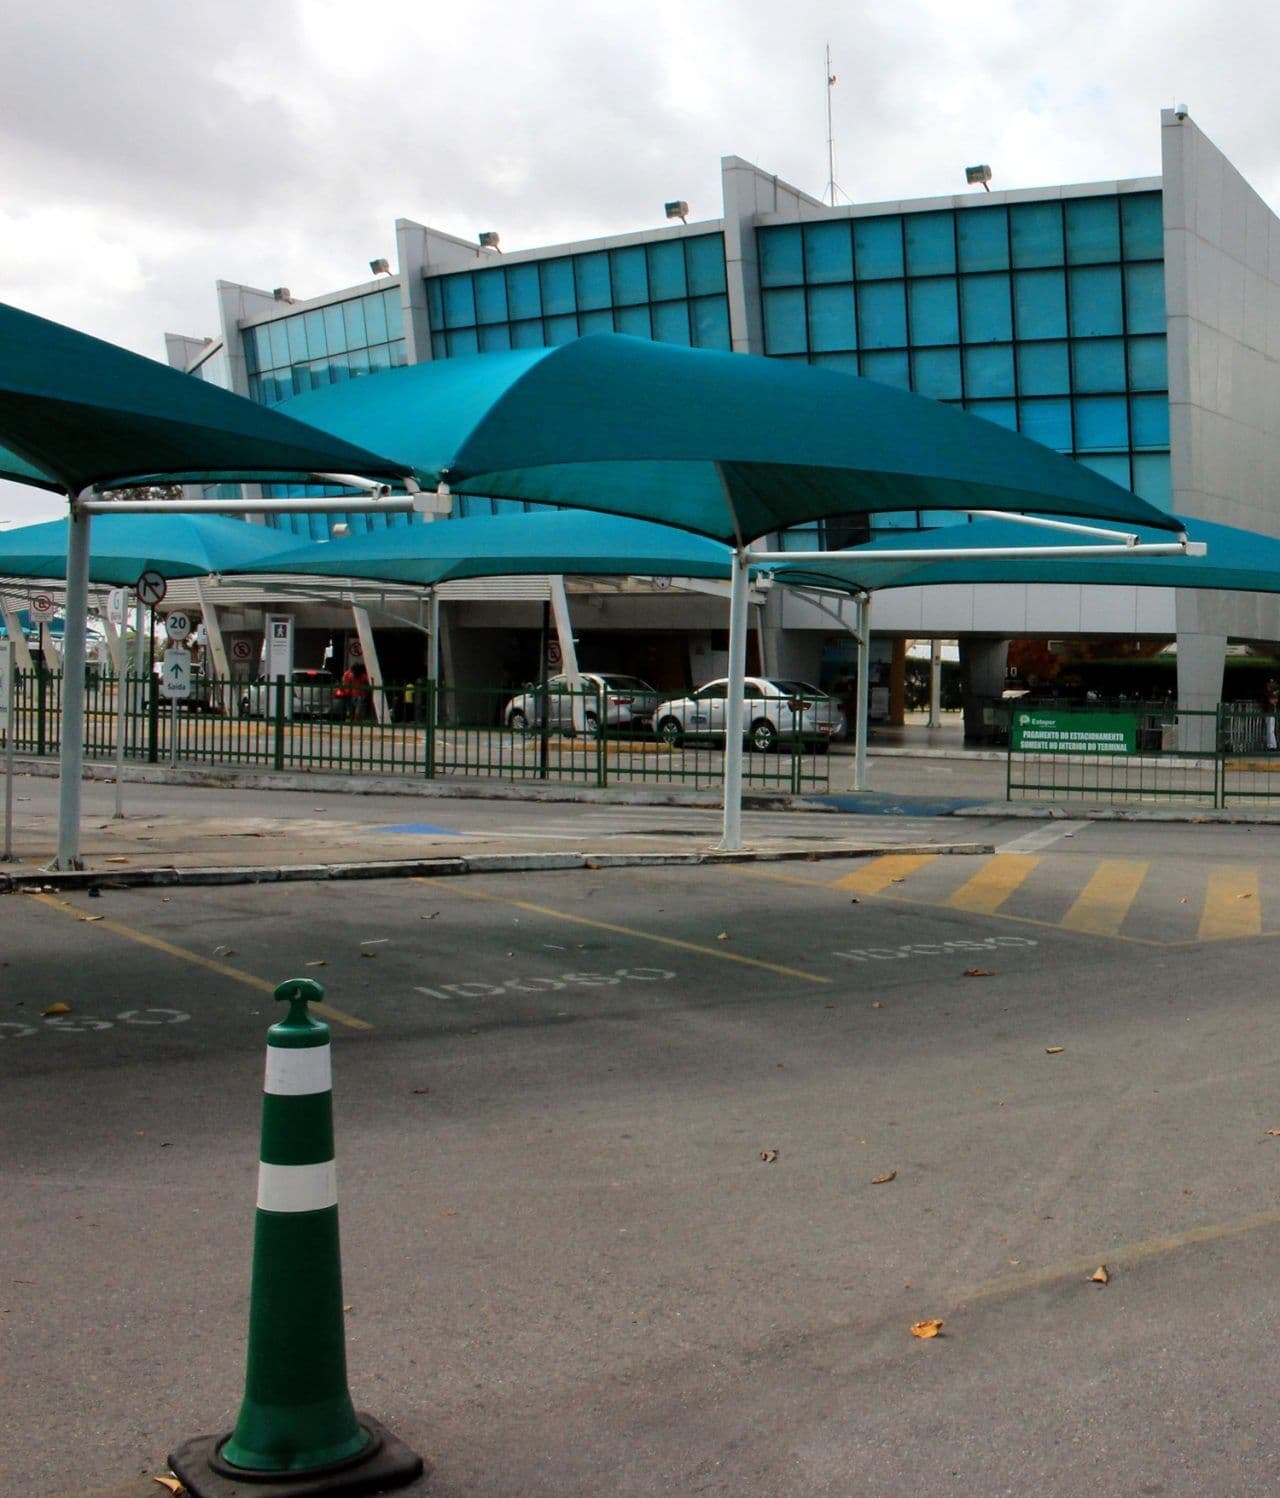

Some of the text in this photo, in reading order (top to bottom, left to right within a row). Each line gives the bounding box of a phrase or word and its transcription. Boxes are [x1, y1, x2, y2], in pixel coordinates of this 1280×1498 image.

[170, 616, 186, 629] 20
[1023, 730, 1124, 741] PAGAMENTO DO ESTACIONAMENTO
[1020, 740, 1048, 750] SOMENTE
[1058, 742, 1087, 751] INTERIOR
[1097, 743, 1128, 752] TERMINAL
[832, 936, 1039, 962] IDOSO
[413, 967, 677, 1000] IDOSO
